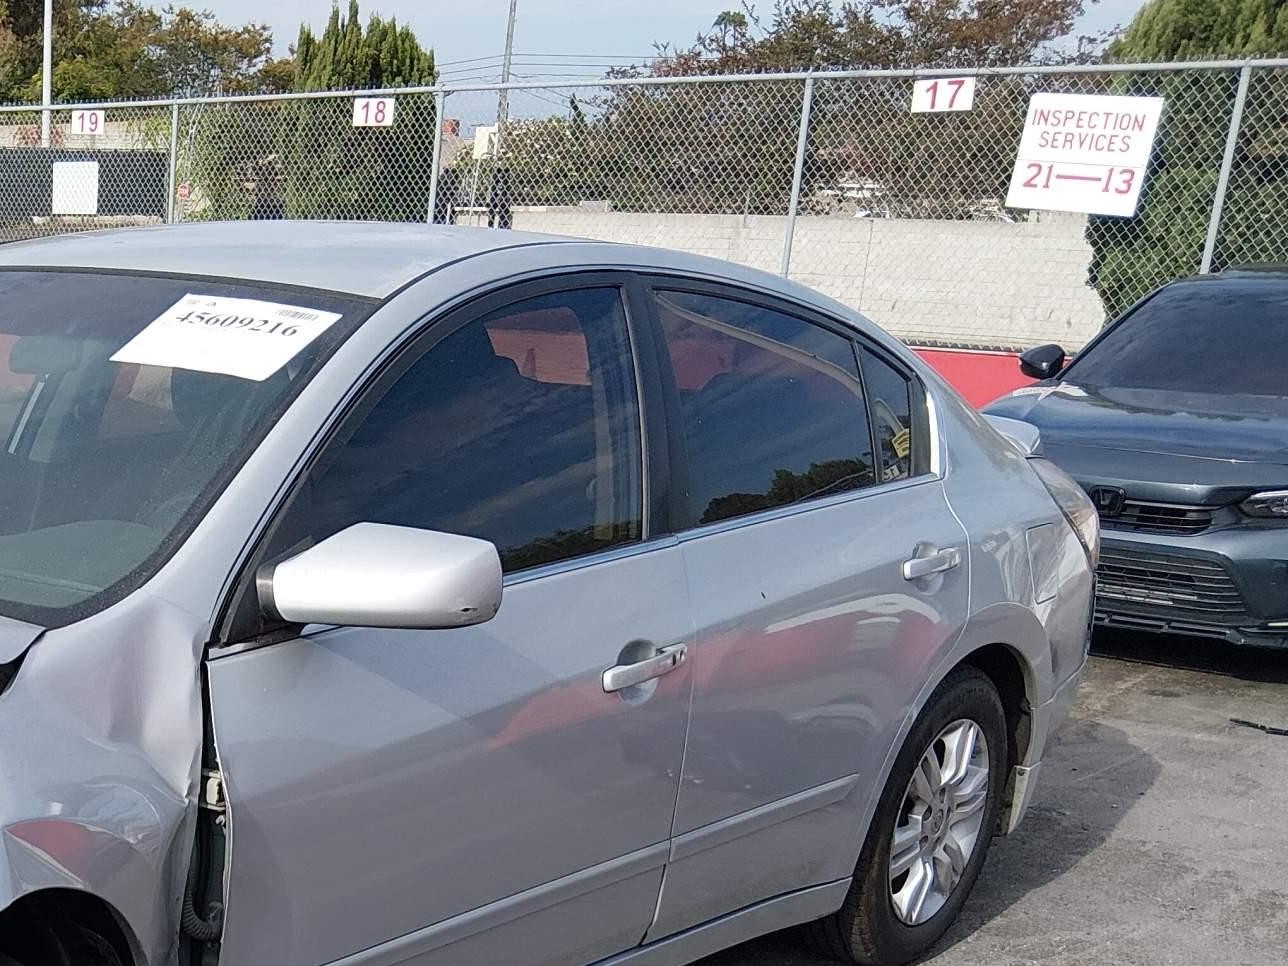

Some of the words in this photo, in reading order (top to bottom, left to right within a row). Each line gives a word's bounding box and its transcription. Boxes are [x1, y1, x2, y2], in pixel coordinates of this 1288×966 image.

[925, 79, 965, 110] 17
[78, 111, 98, 133] 19
[361, 100, 387, 125] 18
[1031, 108, 1147, 132] INSPECTION
[1037, 130, 1132, 153] SERVICES
[175, 310, 303, 338] 45609216
